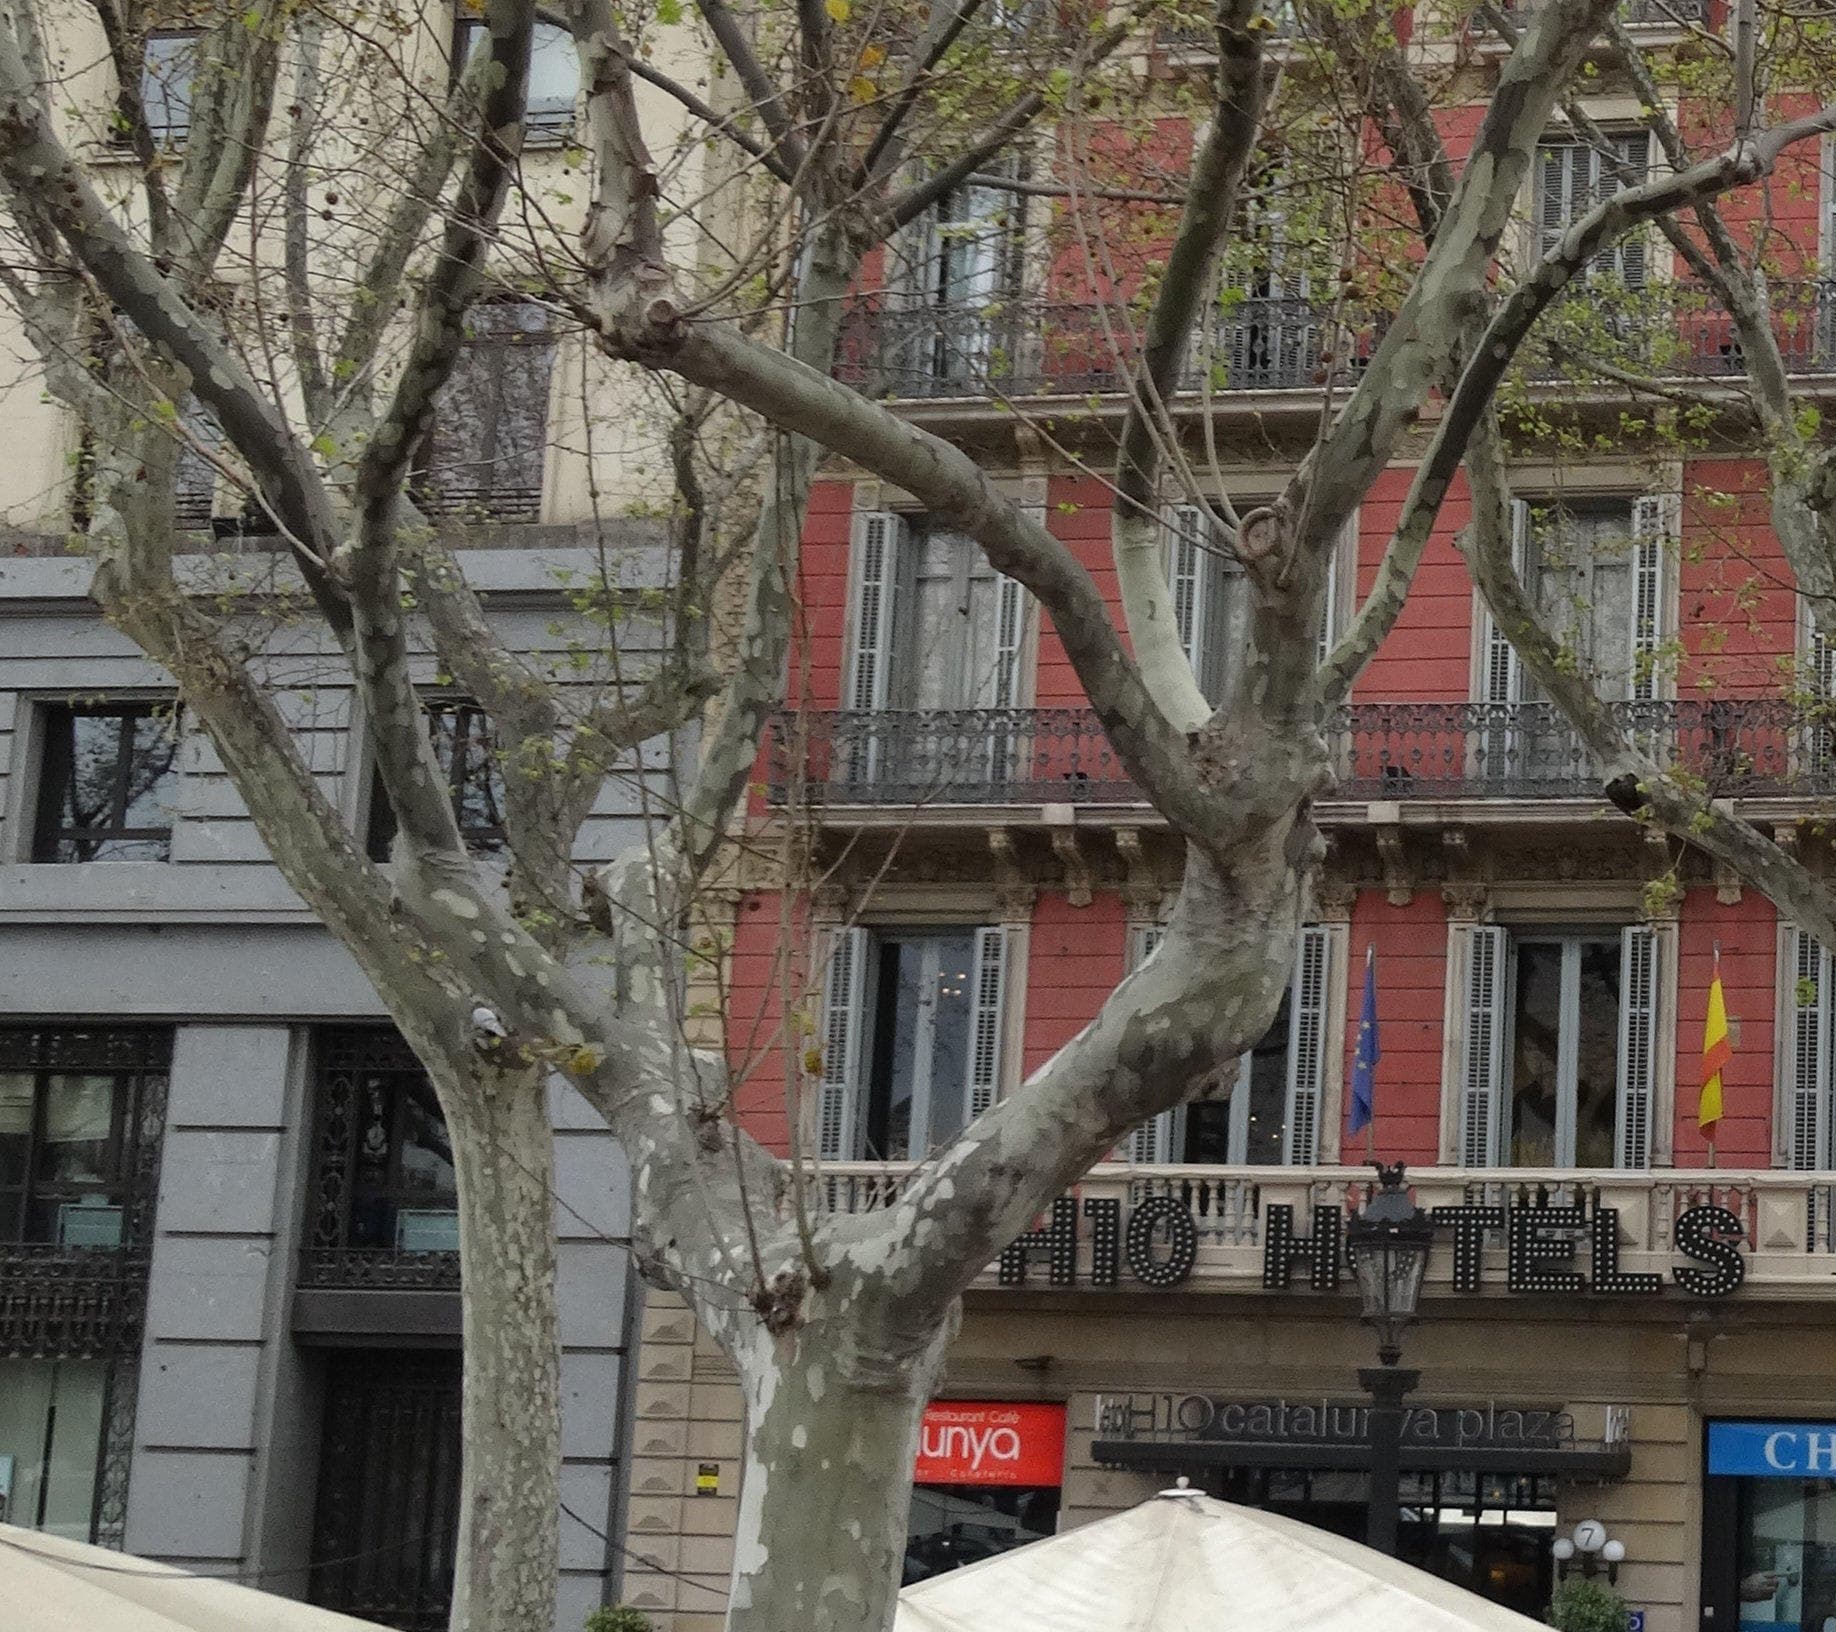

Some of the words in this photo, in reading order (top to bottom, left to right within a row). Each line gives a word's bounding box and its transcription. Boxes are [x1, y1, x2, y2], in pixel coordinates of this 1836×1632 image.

[1000, 1196, 1197, 1287] H10
[1263, 1203, 1745, 1296] HTELS
[1458, 1400, 1575, 1449] plaza
[1581, 1527, 1596, 1547] 7
